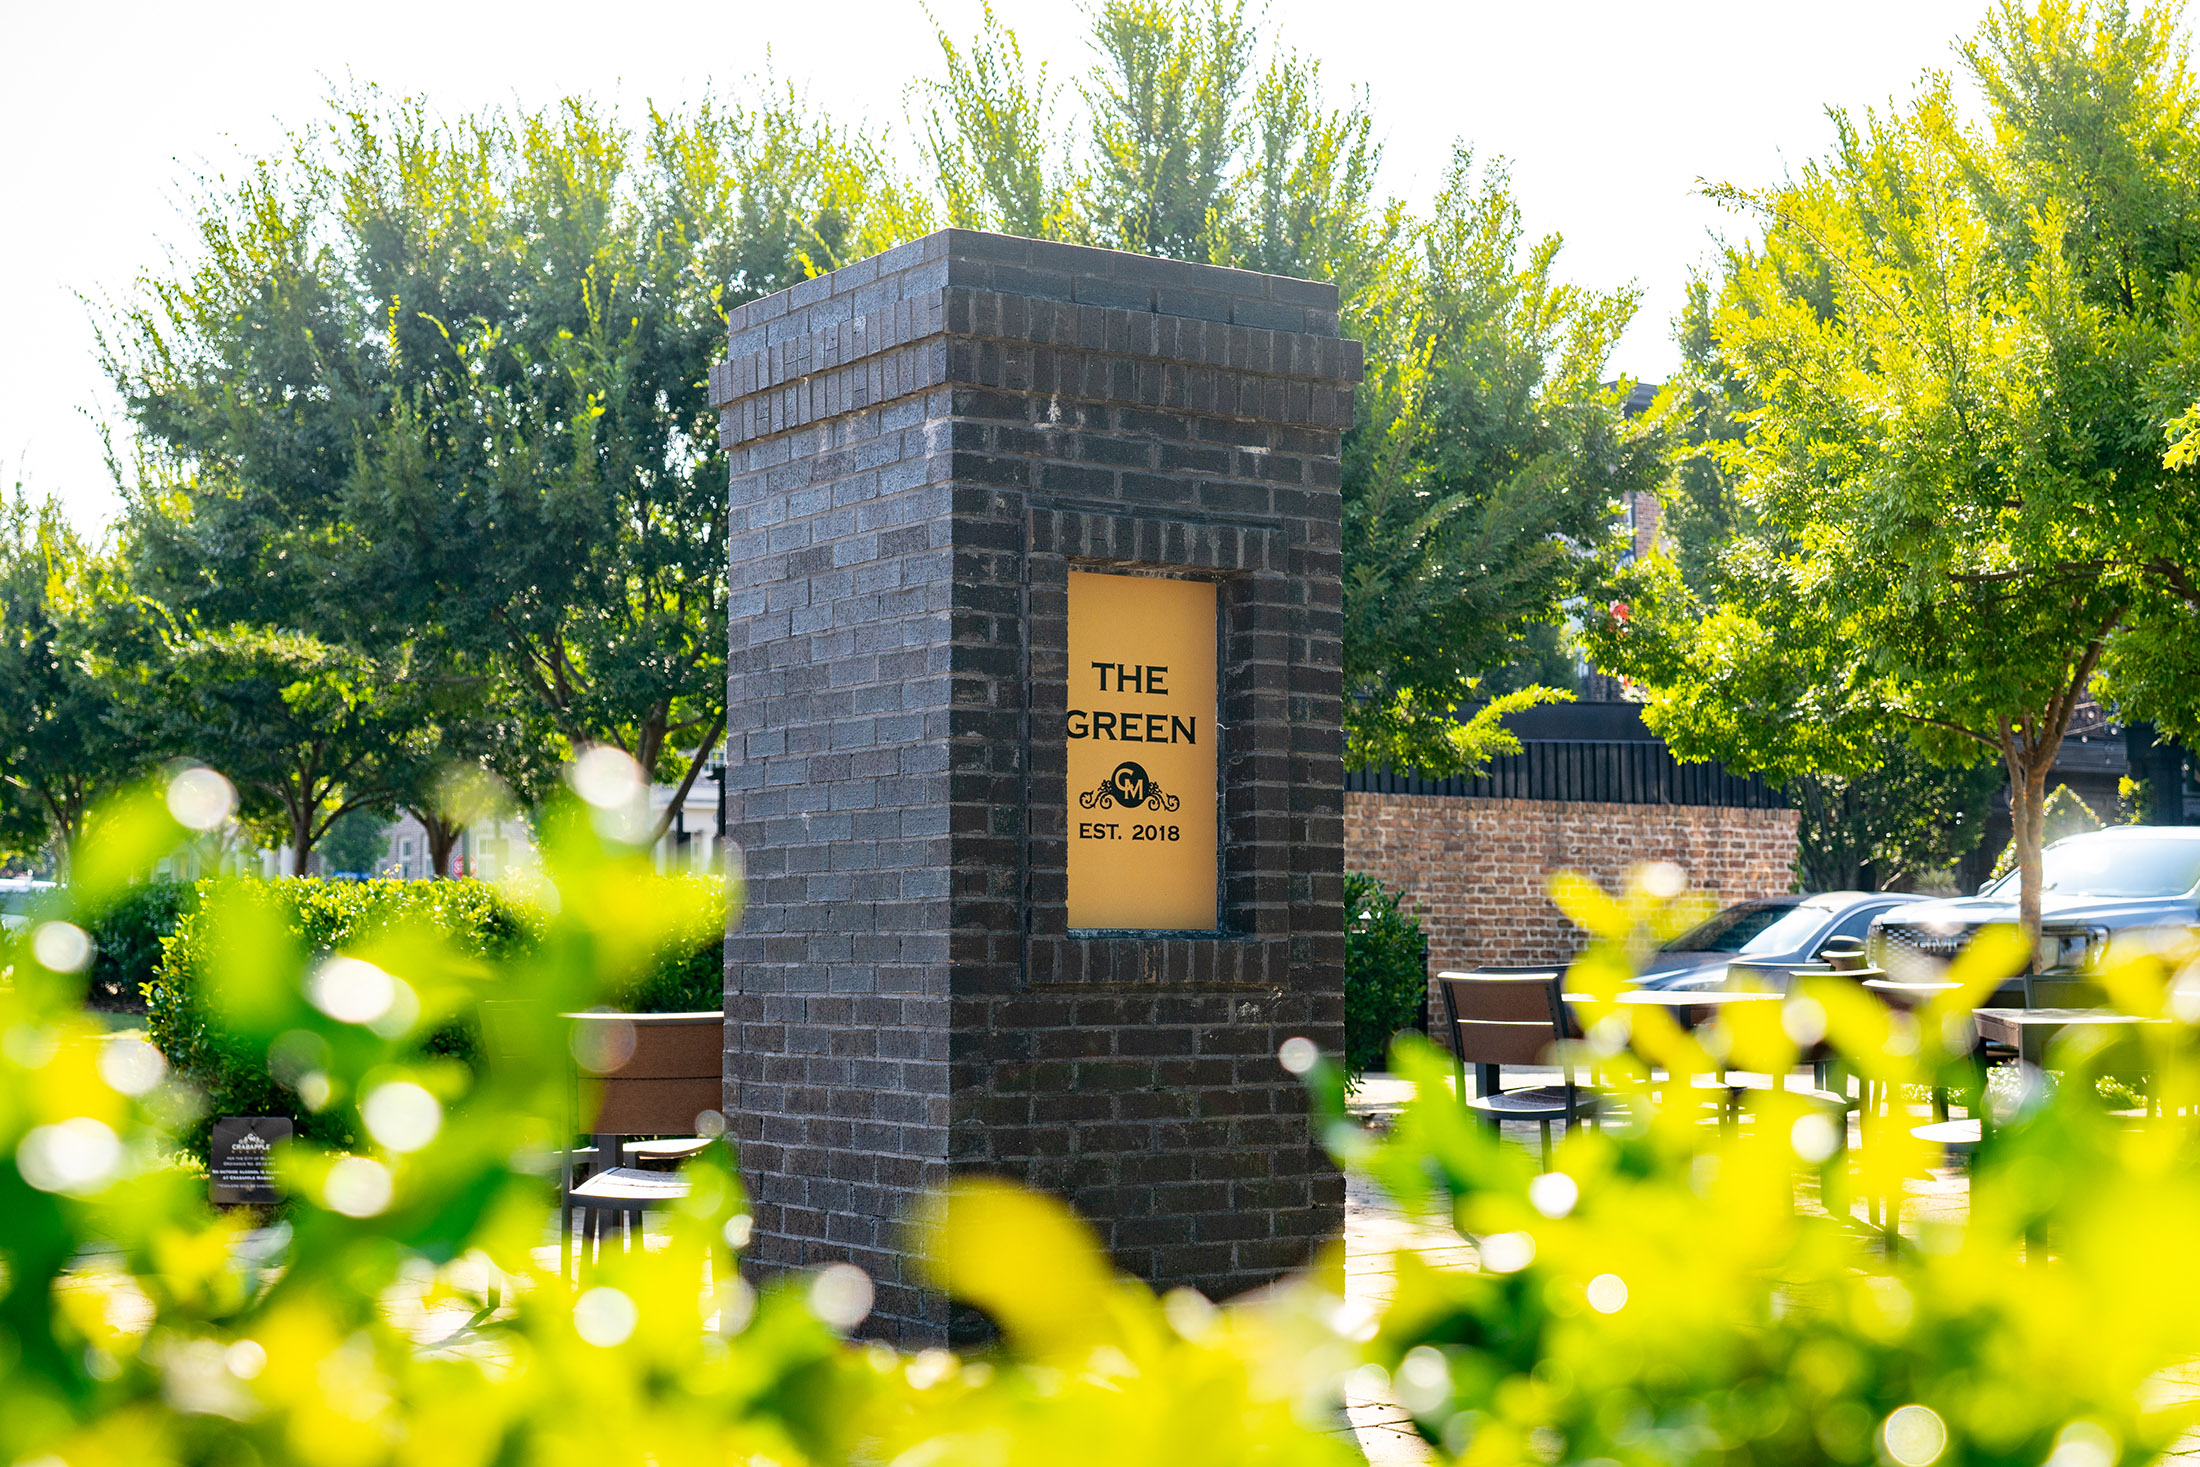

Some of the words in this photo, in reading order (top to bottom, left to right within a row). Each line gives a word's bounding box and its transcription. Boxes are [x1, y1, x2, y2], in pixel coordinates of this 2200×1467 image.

[1091, 661, 1168, 696] THE
[1067, 709, 1196, 745] GREEN
[1114, 767, 1144, 800] CM
[1079, 822, 1122, 841] EST.
[1131, 824, 1180, 842] 2018
